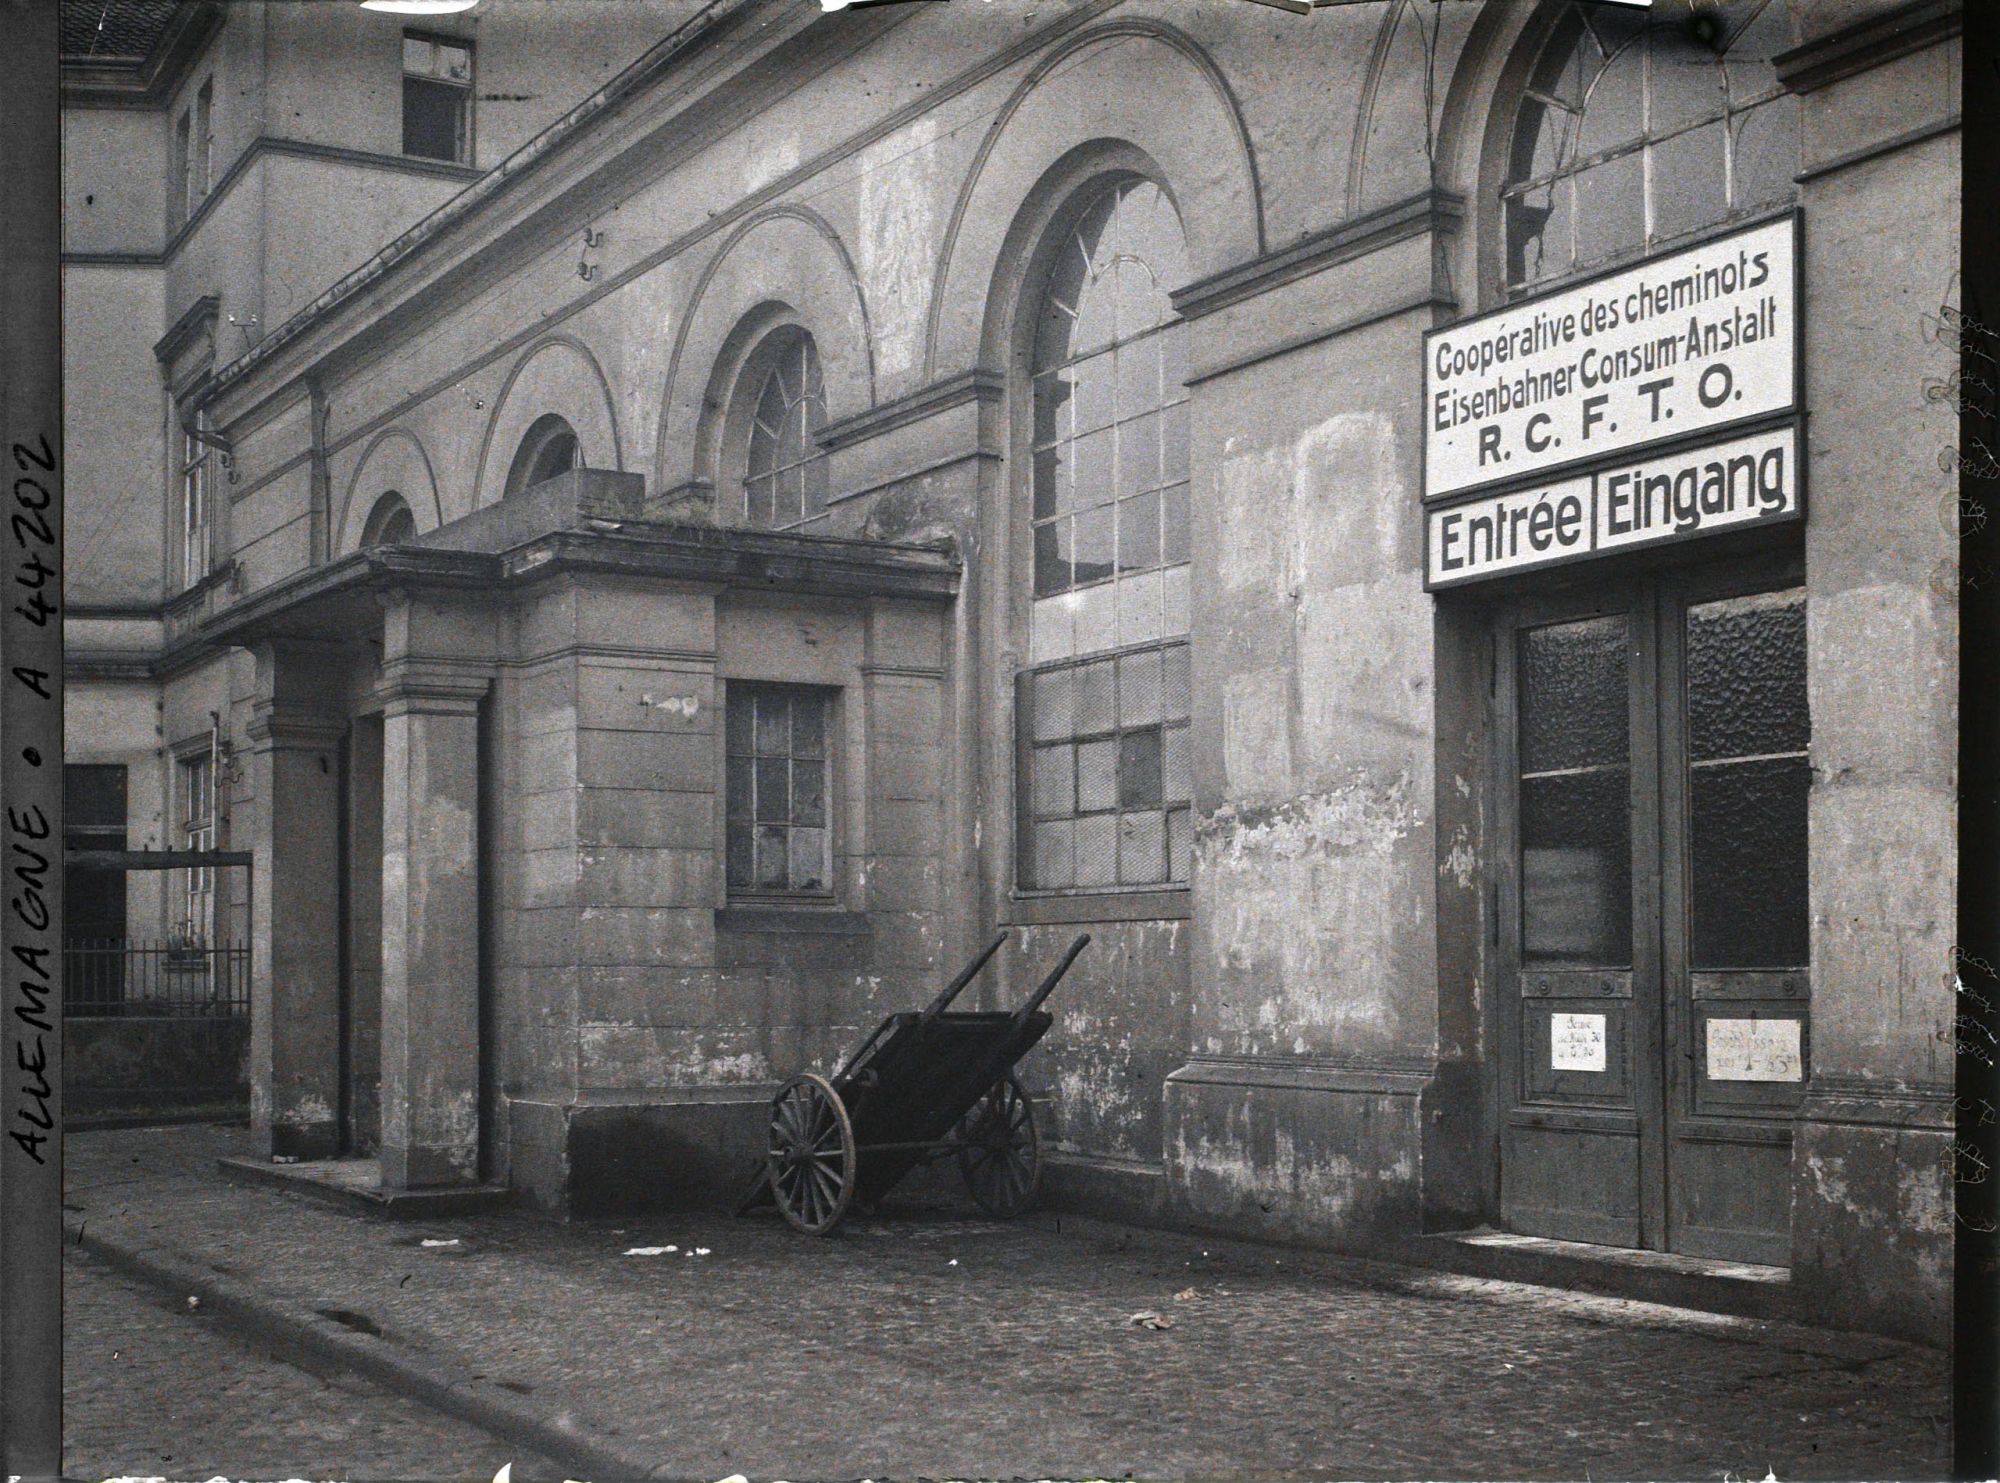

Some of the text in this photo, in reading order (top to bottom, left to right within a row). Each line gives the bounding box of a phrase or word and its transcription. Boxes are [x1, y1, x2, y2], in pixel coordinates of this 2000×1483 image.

[1435, 250, 1770, 381] Coopérative des cheminots
[1435, 296, 1776, 432] Eisenbahner Consum-Anstalt
[1441, 492, 1582, 572] Entrée
[1608, 446, 1787, 534] Eingang
